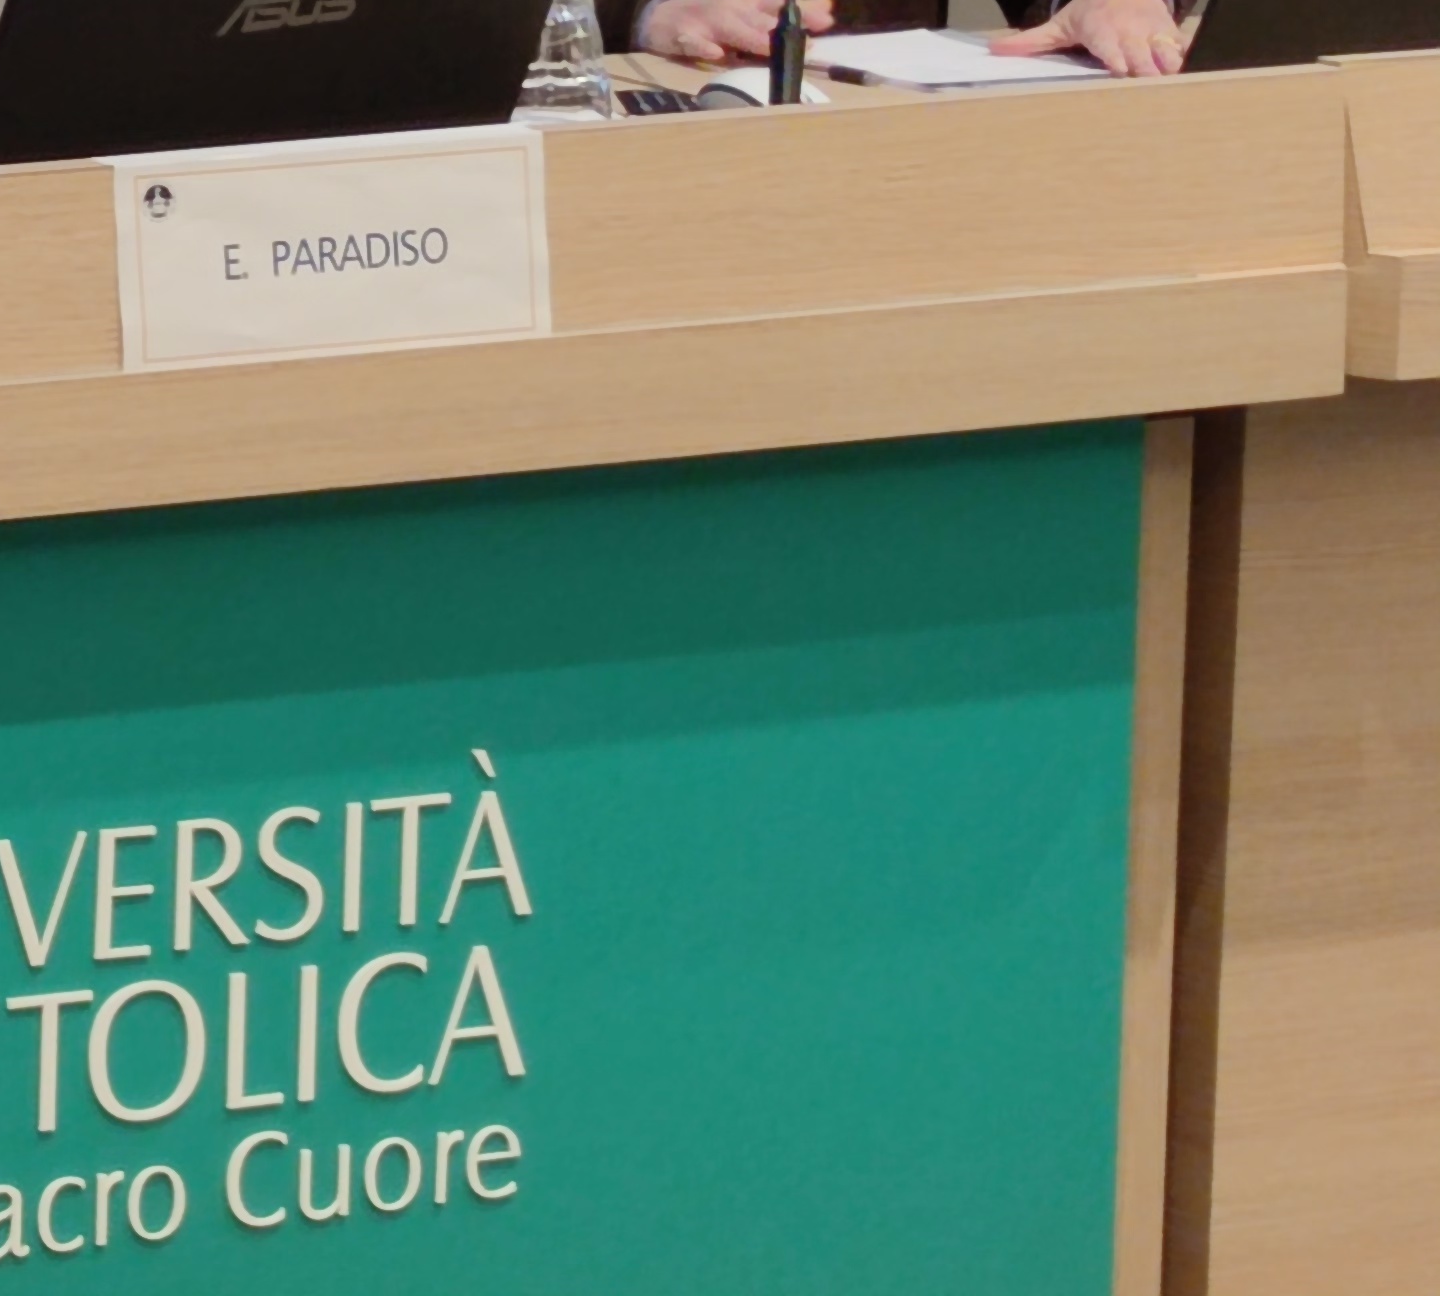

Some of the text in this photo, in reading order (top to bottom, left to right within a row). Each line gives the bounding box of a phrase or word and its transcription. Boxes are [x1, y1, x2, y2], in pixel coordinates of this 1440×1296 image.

[223, 226, 449, 281] E. PARADISO
[226, 1124, 523, 1229] Cuore
